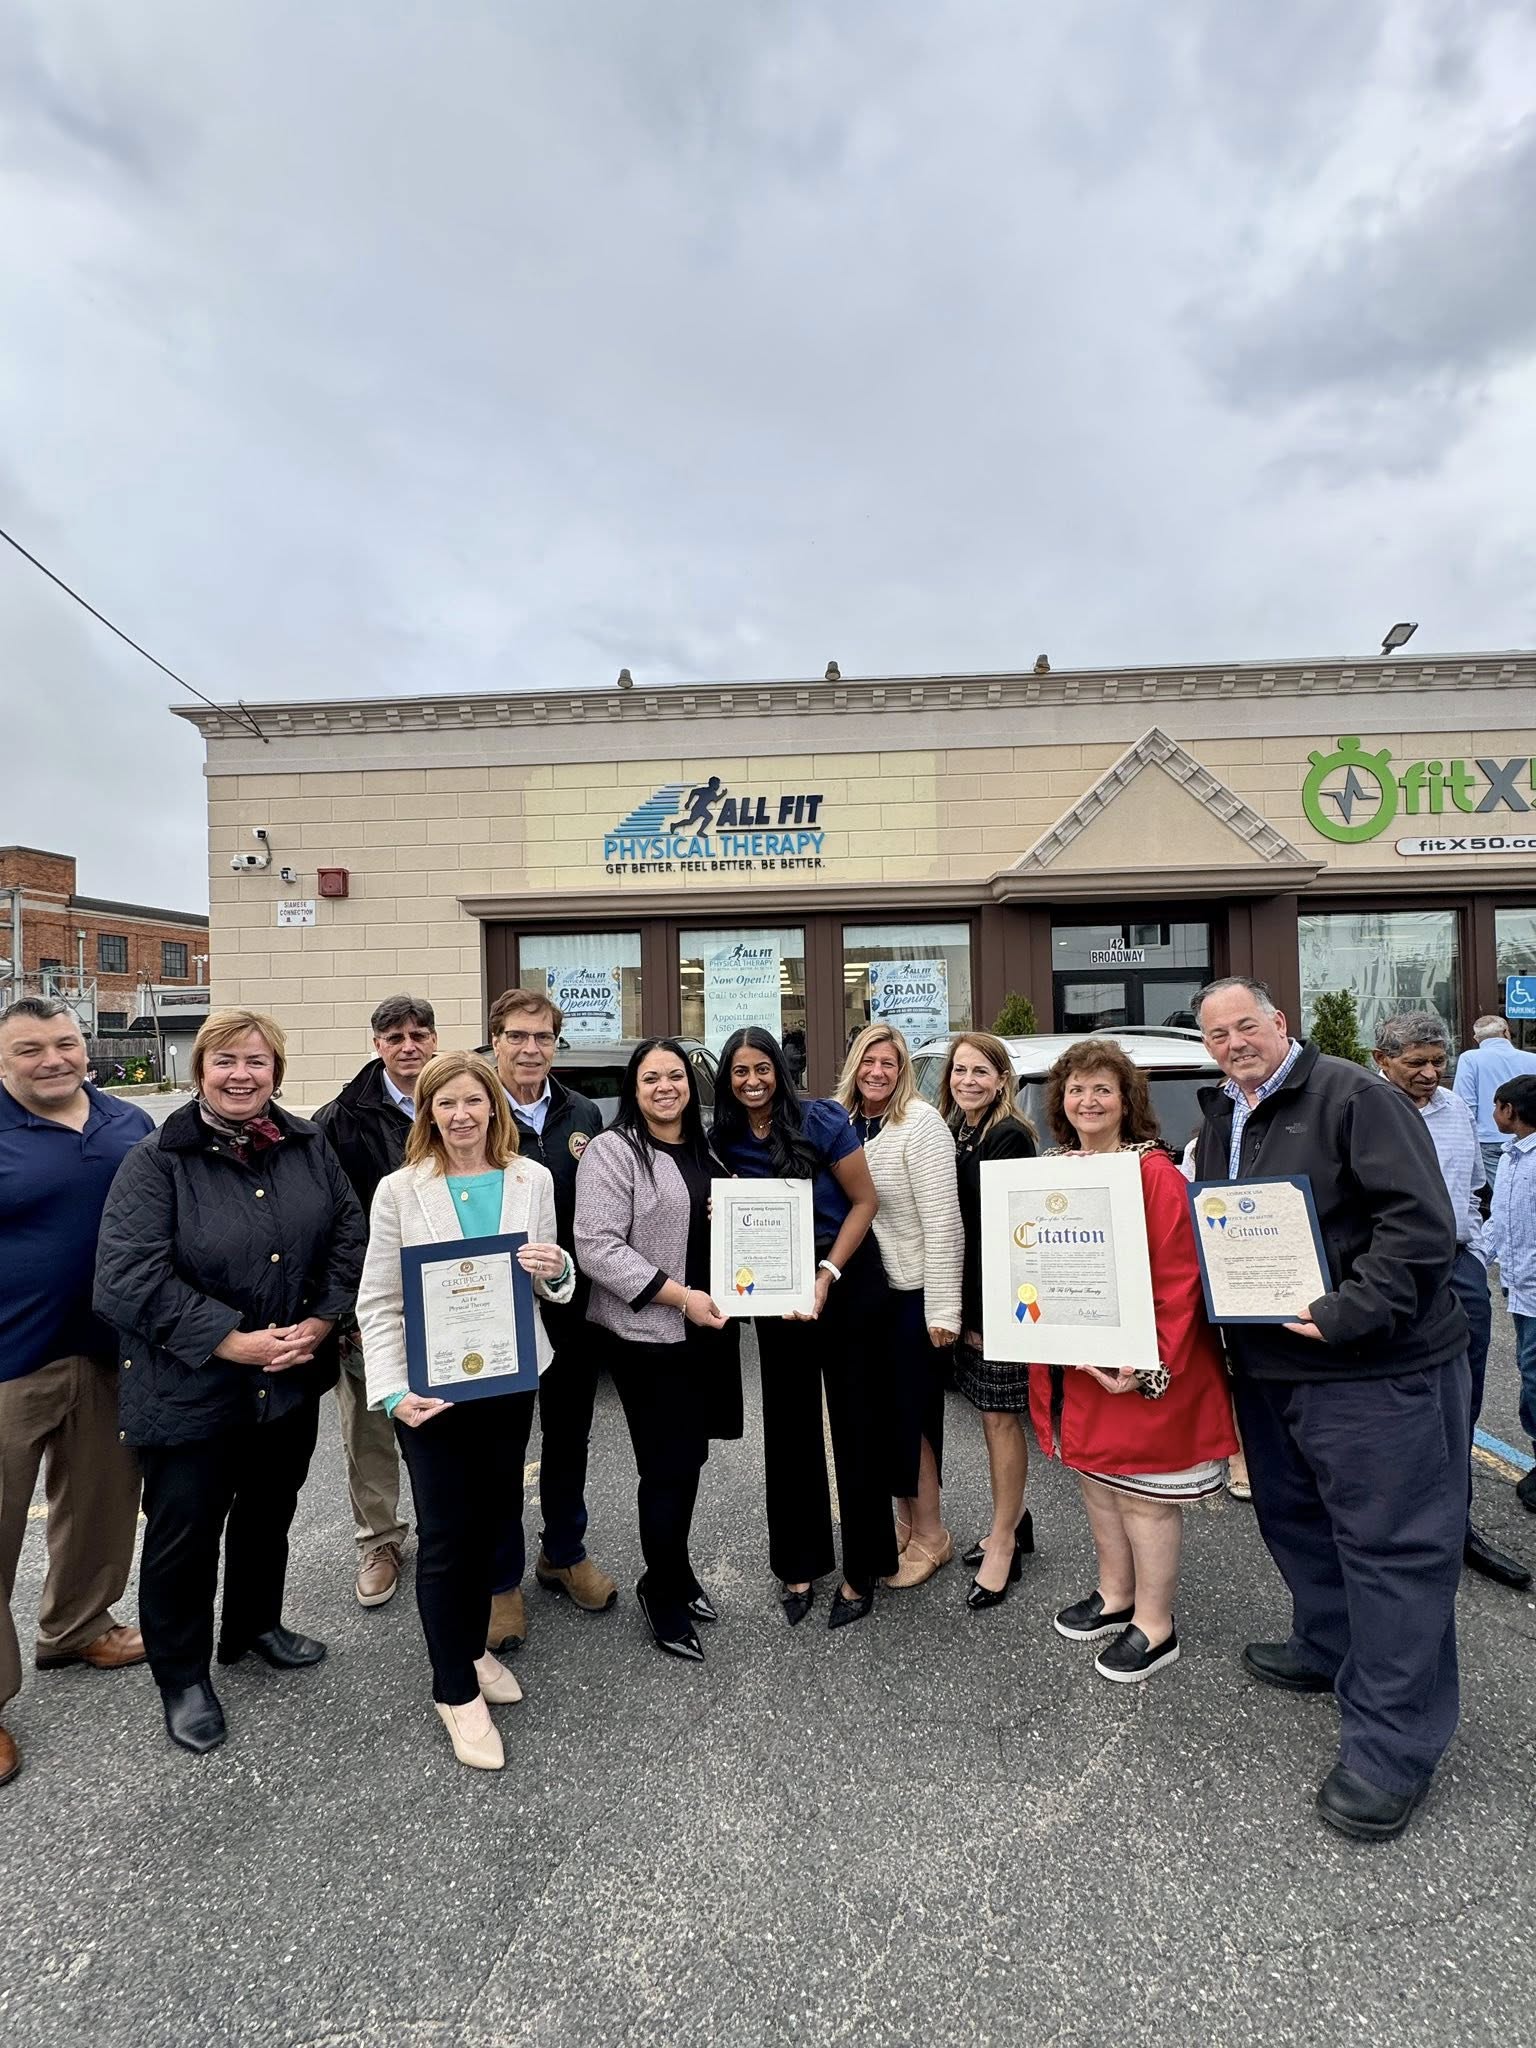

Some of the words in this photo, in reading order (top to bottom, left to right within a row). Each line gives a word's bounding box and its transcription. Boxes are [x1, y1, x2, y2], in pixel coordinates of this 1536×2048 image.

[1399, 757, 1536, 814] fitX
[716, 796, 770, 826] ALL
[778, 794, 824, 825] FIT
[604, 836, 716, 861] PHYSICAL
[720, 832, 825, 857] THERAPY
[606, 863, 627, 874] GET
[631, 862, 676, 874] BETTER.
[680, 861, 708, 872] FEEL
[711, 860, 756, 871] BETTER.
[761, 859, 776, 870] BE
[780, 858, 826, 869] BETTER.
[1111, 938, 1123, 950] 42
[742, 949, 757, 958] ALL
[760, 948, 773, 957] FIT
[1091, 950, 1143, 963] BROADWAY
[743, 959, 774, 967] THERAPY
[710, 975, 734, 985] Now
[736, 974, 776, 986] Open!!!
[560, 987, 611, 999] GRAND
[708, 991, 727, 999] Call
[729, 991, 737, 999] to
[739, 990, 778, 999] Schedule
[883, 983, 937, 995] GRAND
[560, 996, 614, 1011] Opening!
[736, 1002, 748, 1010] An
[883, 991, 939, 1008] Opening!
[1508, 1006, 1536, 1014] PARKING
[742, 1213, 781, 1227] Citation
[1013, 1221, 1105, 1249] Citation
[1227, 1225, 1279, 1239] Citation
[441, 1274, 494, 1287] CERTIFICATE
